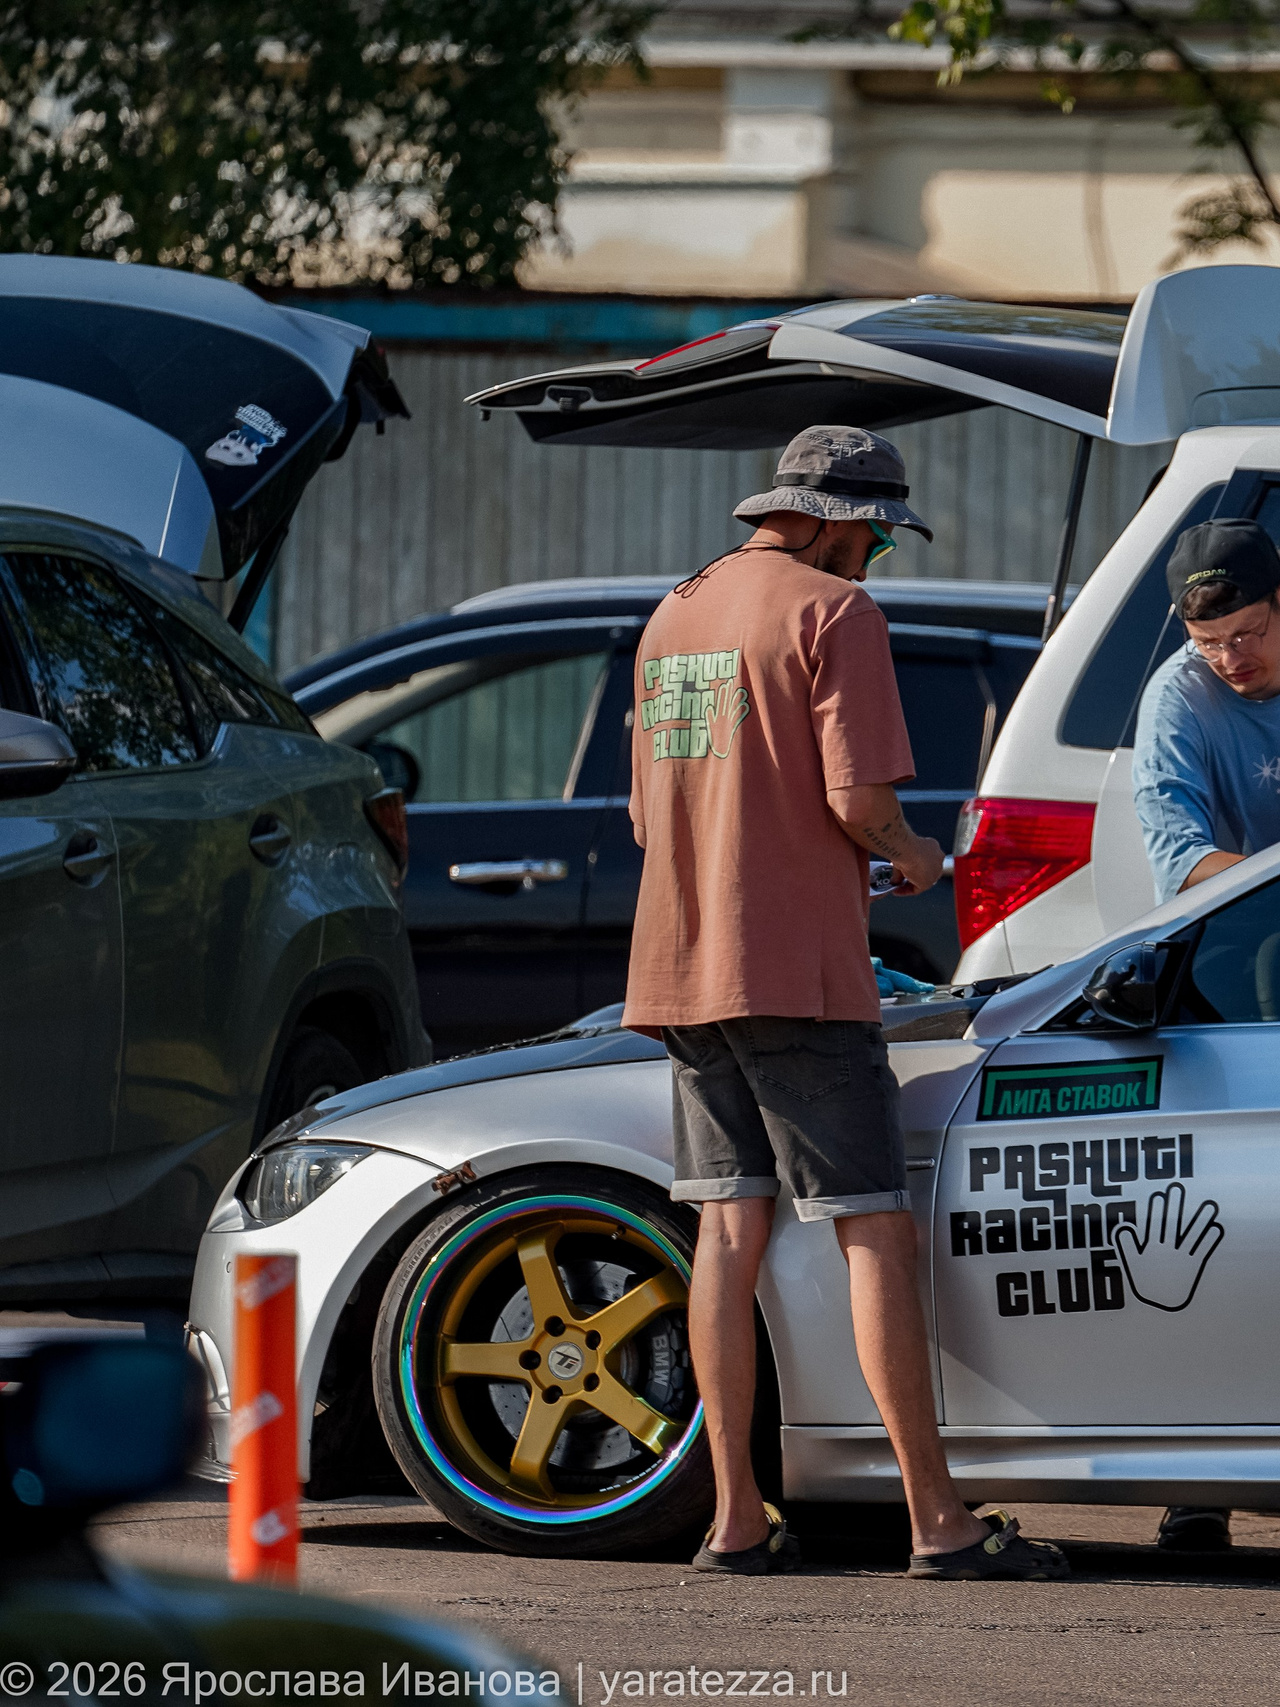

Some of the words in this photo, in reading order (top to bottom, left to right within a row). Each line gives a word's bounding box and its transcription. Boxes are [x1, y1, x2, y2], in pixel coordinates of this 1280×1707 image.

[1185, 569, 1226, 584] JORDAN
[997, 1088, 1052, 1115] ЛИГА
[1056, 1081, 1142, 1112] СТАВОК
[652, 1333, 670, 1387] BMW
